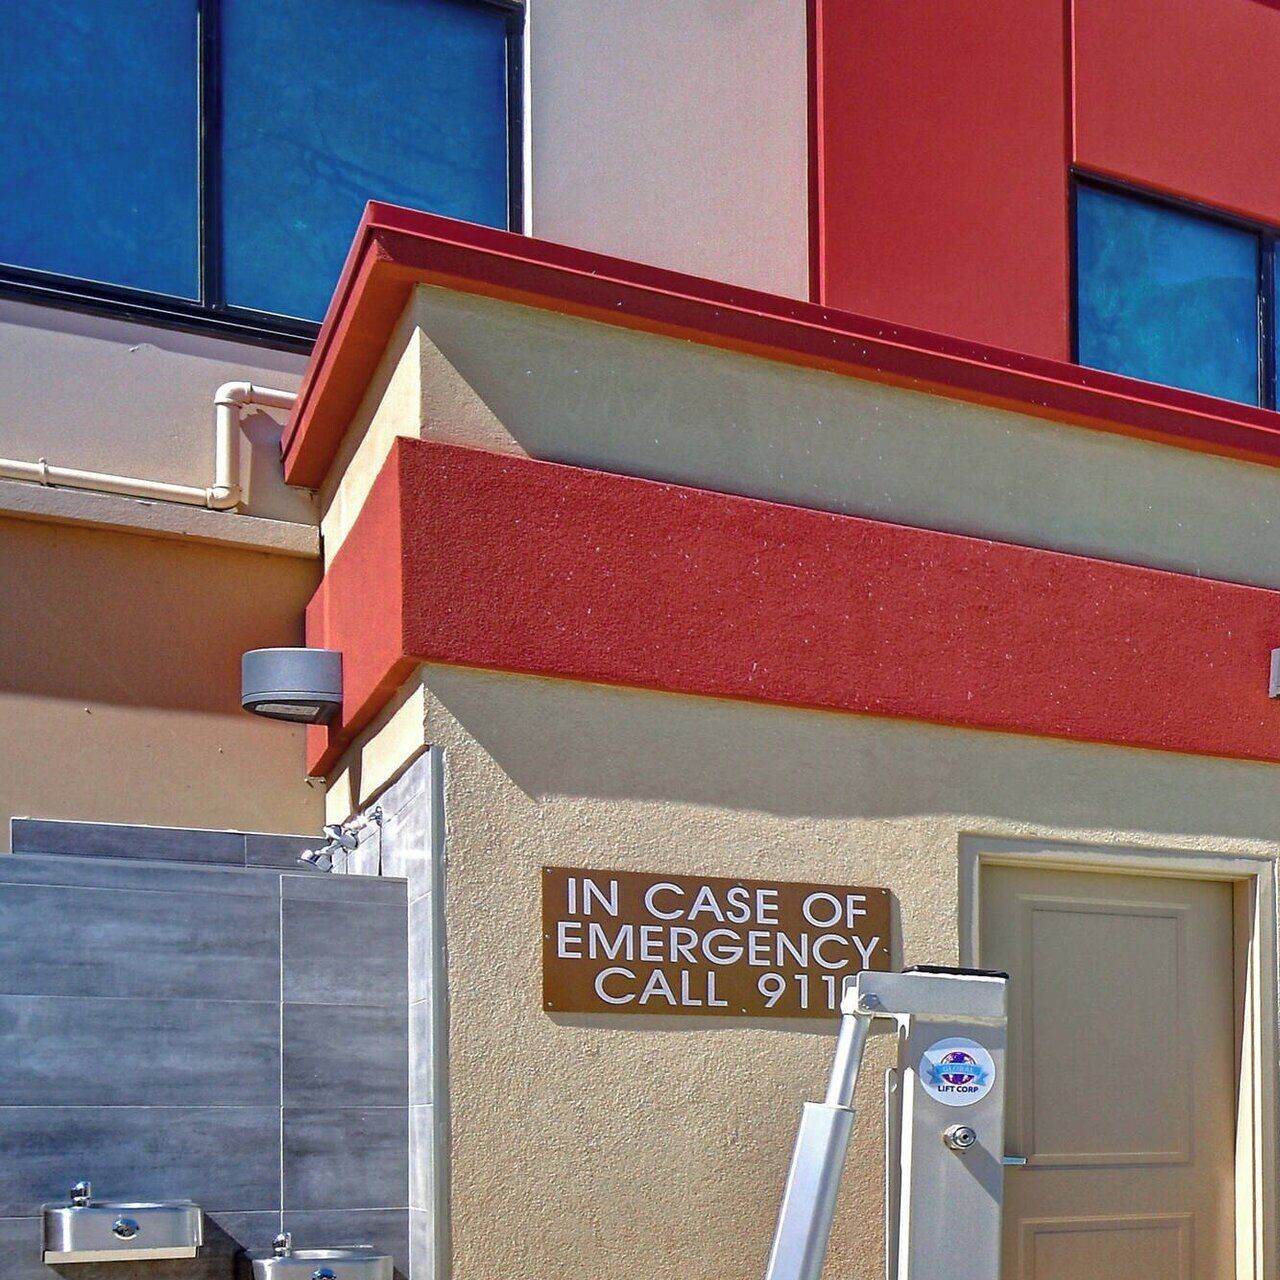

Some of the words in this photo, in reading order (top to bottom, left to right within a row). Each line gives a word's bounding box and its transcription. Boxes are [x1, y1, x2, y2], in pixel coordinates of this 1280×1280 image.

[567, 877, 619, 917] IN
[643, 882, 779, 926] CASE
[802, 891, 867, 929] OF
[557, 921, 880, 970] EMERGENCY
[594, 967, 728, 1007] CALL
[757, 972, 836, 1010] 911
